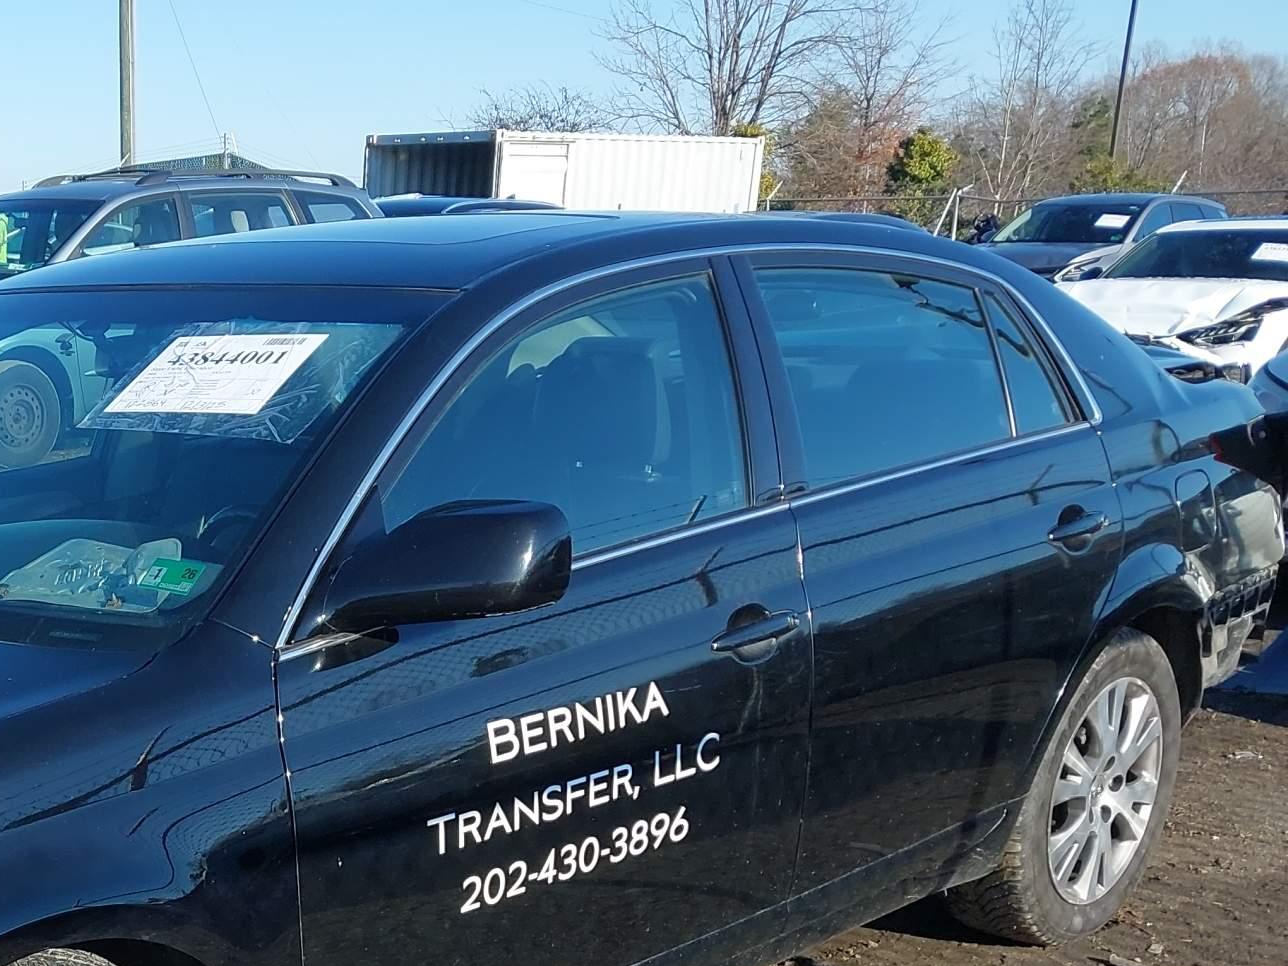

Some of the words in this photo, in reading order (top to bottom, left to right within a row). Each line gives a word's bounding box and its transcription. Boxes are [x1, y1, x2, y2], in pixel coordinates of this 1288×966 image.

[168, 350, 288, 366] 43844001
[181, 567, 198, 580] 26
[486, 680, 670, 764] BERNIKA
[426, 763, 641, 855] TRANSFER,
[653, 732, 721, 787] LLC
[460, 806, 690, 914] 202-430-3896
